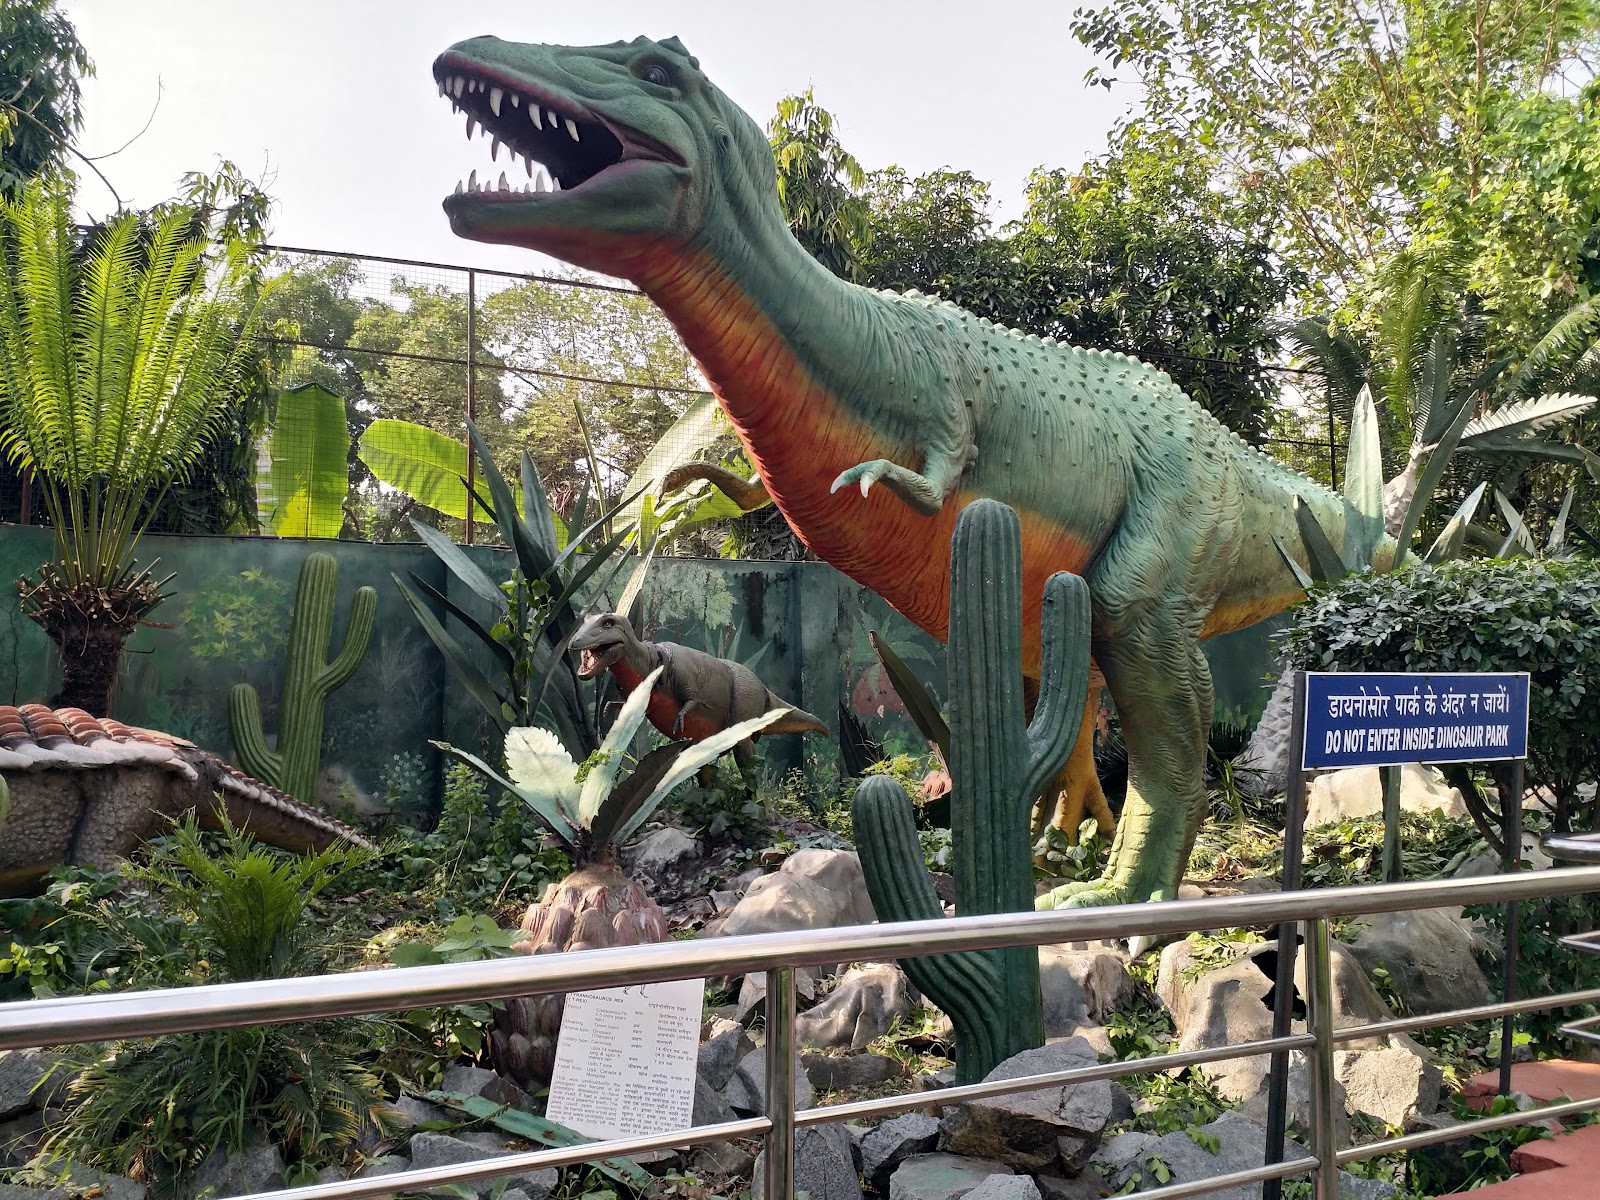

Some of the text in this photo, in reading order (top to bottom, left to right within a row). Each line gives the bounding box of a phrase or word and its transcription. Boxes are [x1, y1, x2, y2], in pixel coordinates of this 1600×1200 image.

[1328, 685, 1509, 718] डायनोसोर पार्क के अंदर न जायें।
[1325, 725, 1508, 754] DO NOT ENTER INSIDE DINOSAUR PARK
